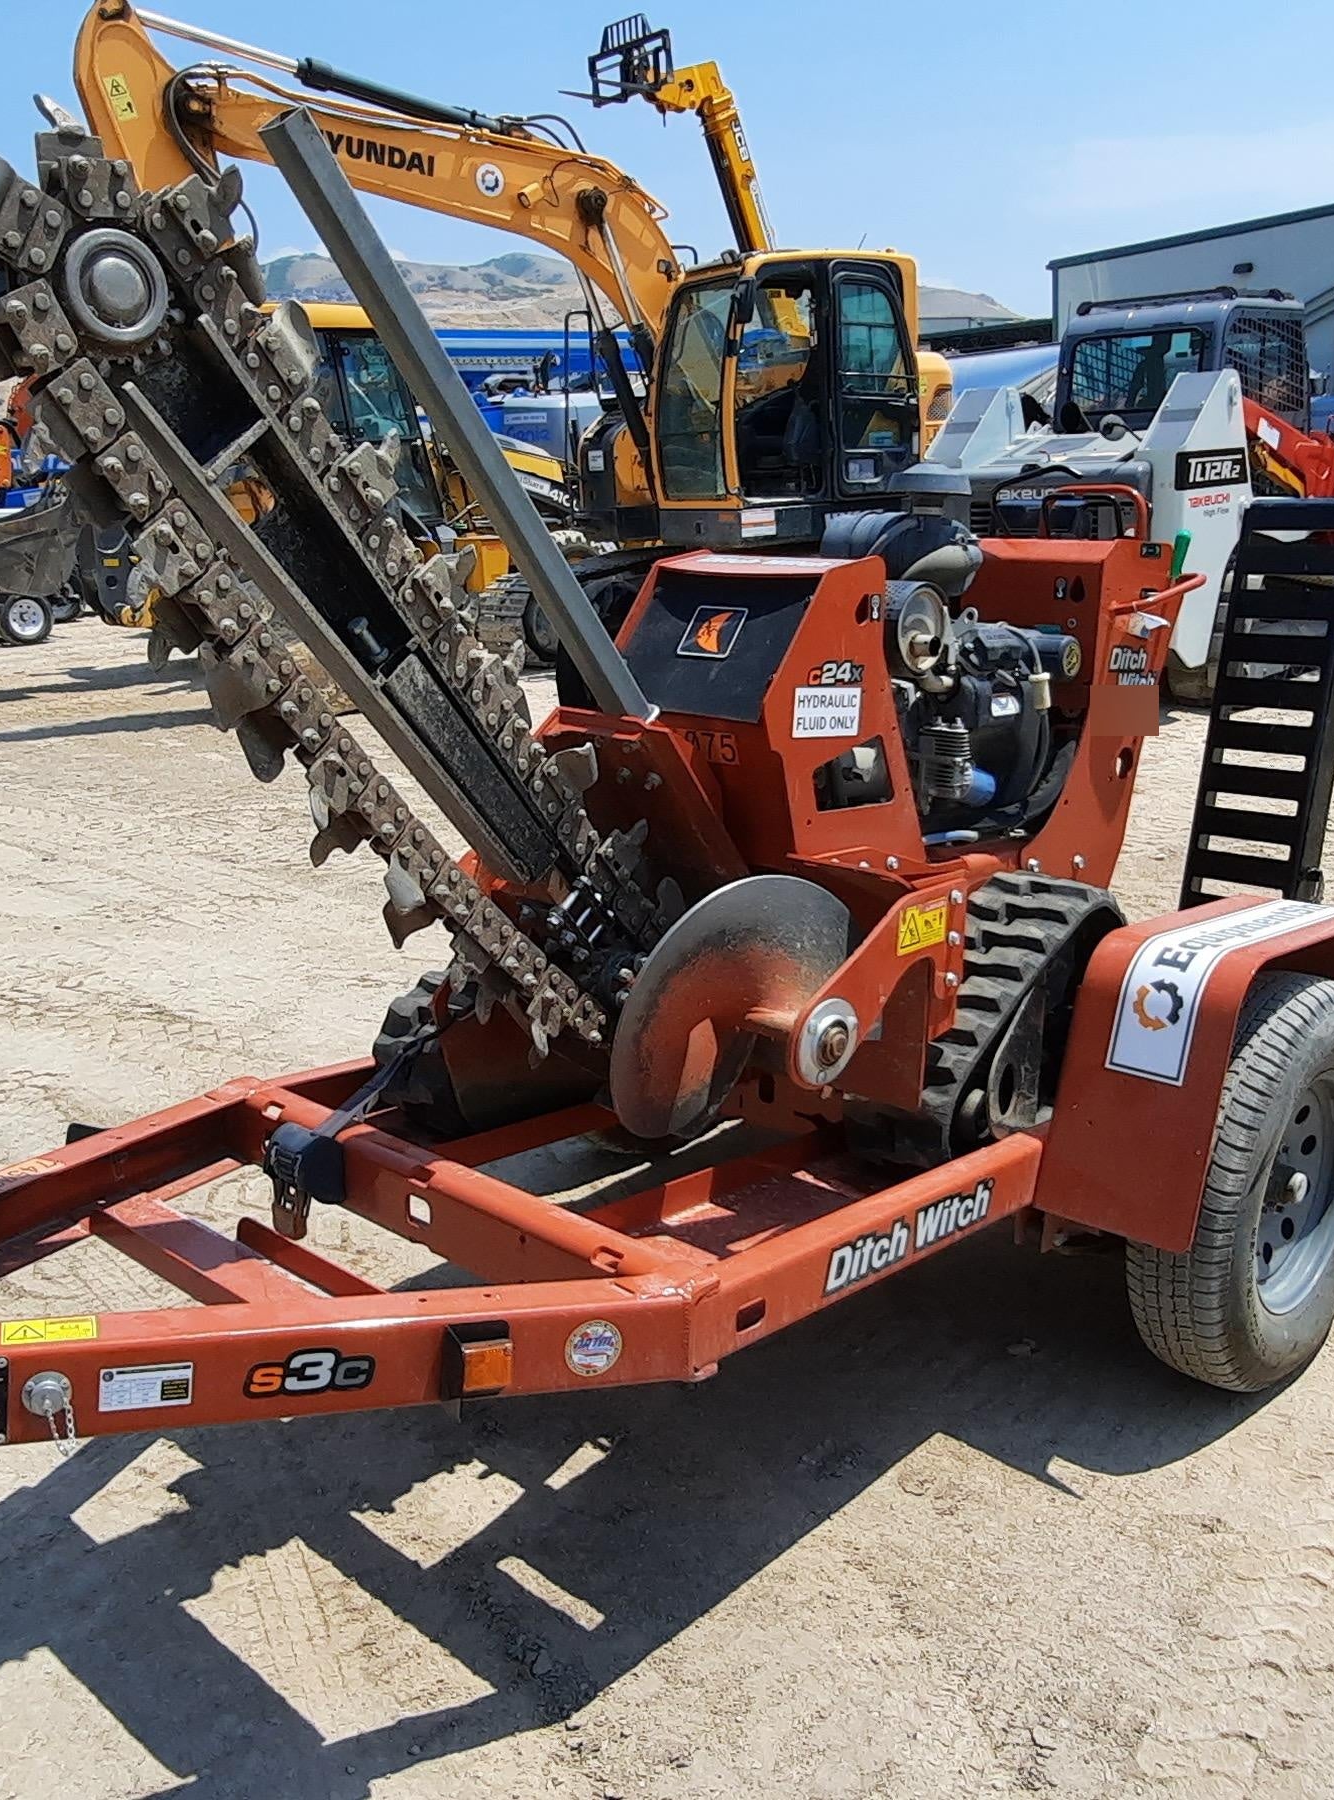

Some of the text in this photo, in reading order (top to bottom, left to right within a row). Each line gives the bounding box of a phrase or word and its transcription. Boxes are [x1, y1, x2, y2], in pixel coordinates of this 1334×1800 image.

[319, 129, 435, 177] YUNDAI
[731, 119, 750, 161] JCB
[1109, 647, 1147, 670] Ditch
[797, 694, 858, 709] HYDRAULIC
[796, 715, 856, 732] FLUID ONLY
[826, 1183, 992, 1292] Ditch Witch
